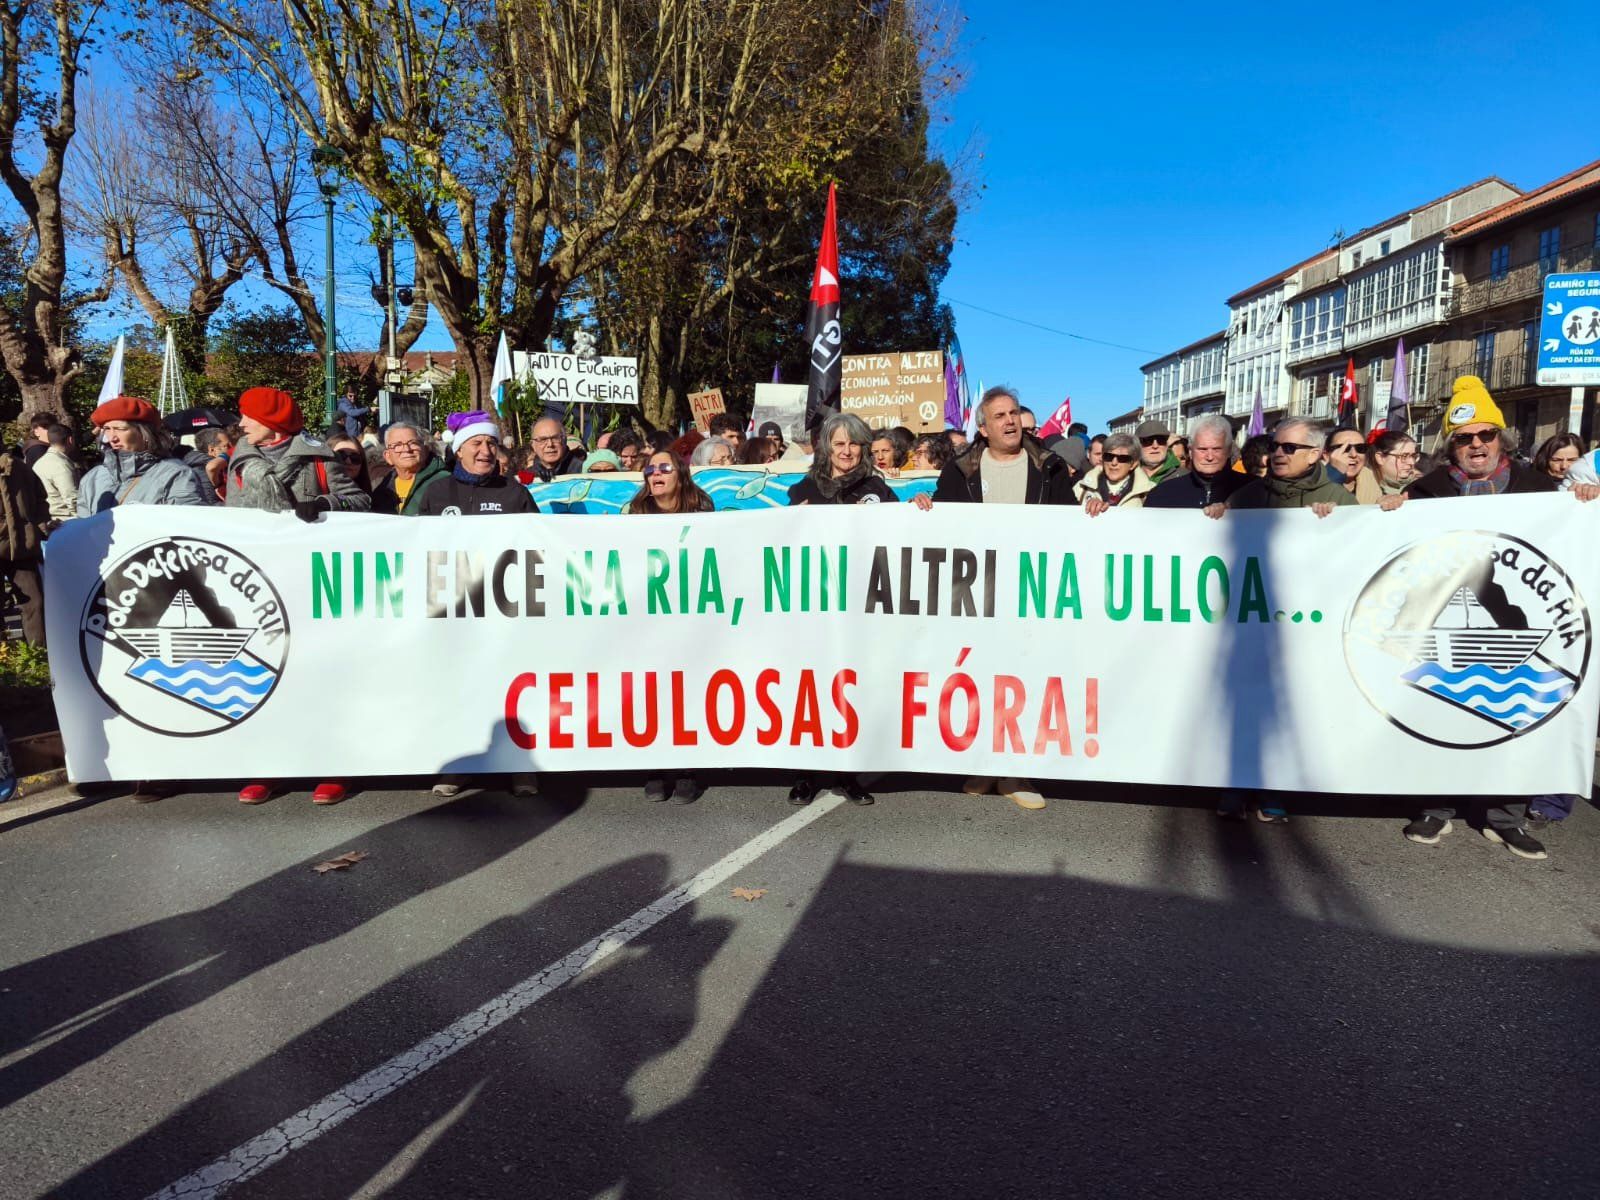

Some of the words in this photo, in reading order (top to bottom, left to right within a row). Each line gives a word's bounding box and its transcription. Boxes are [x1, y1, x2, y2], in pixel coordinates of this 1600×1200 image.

[1549, 279, 1585, 289] CAMIÑO
[1570, 347, 1584, 355] RÚA
[841, 357, 892, 373] CONTRA
[901, 353, 939, 370] ALTRI
[896, 374, 934, 385] SOCIAL
[694, 393, 723, 412] ALTRI
[123, 545, 228, 588] Defensa
[230, 569, 261, 602] da
[311, 551, 404, 619] NIN
[426, 549, 546, 619] ENCE
[566, 549, 628, 616] NA
[647, 526, 744, 626] RÍA,
[764, 545, 848, 613] NIN
[864, 545, 997, 618] ALTRI
[1018, 551, 1083, 619] NA
[1104, 553, 1323, 624] ULLOA...
[1520, 564, 1556, 601] da
[505, 668, 860, 750] CELULOSAS
[901, 647, 1100, 758] FÓRA!
